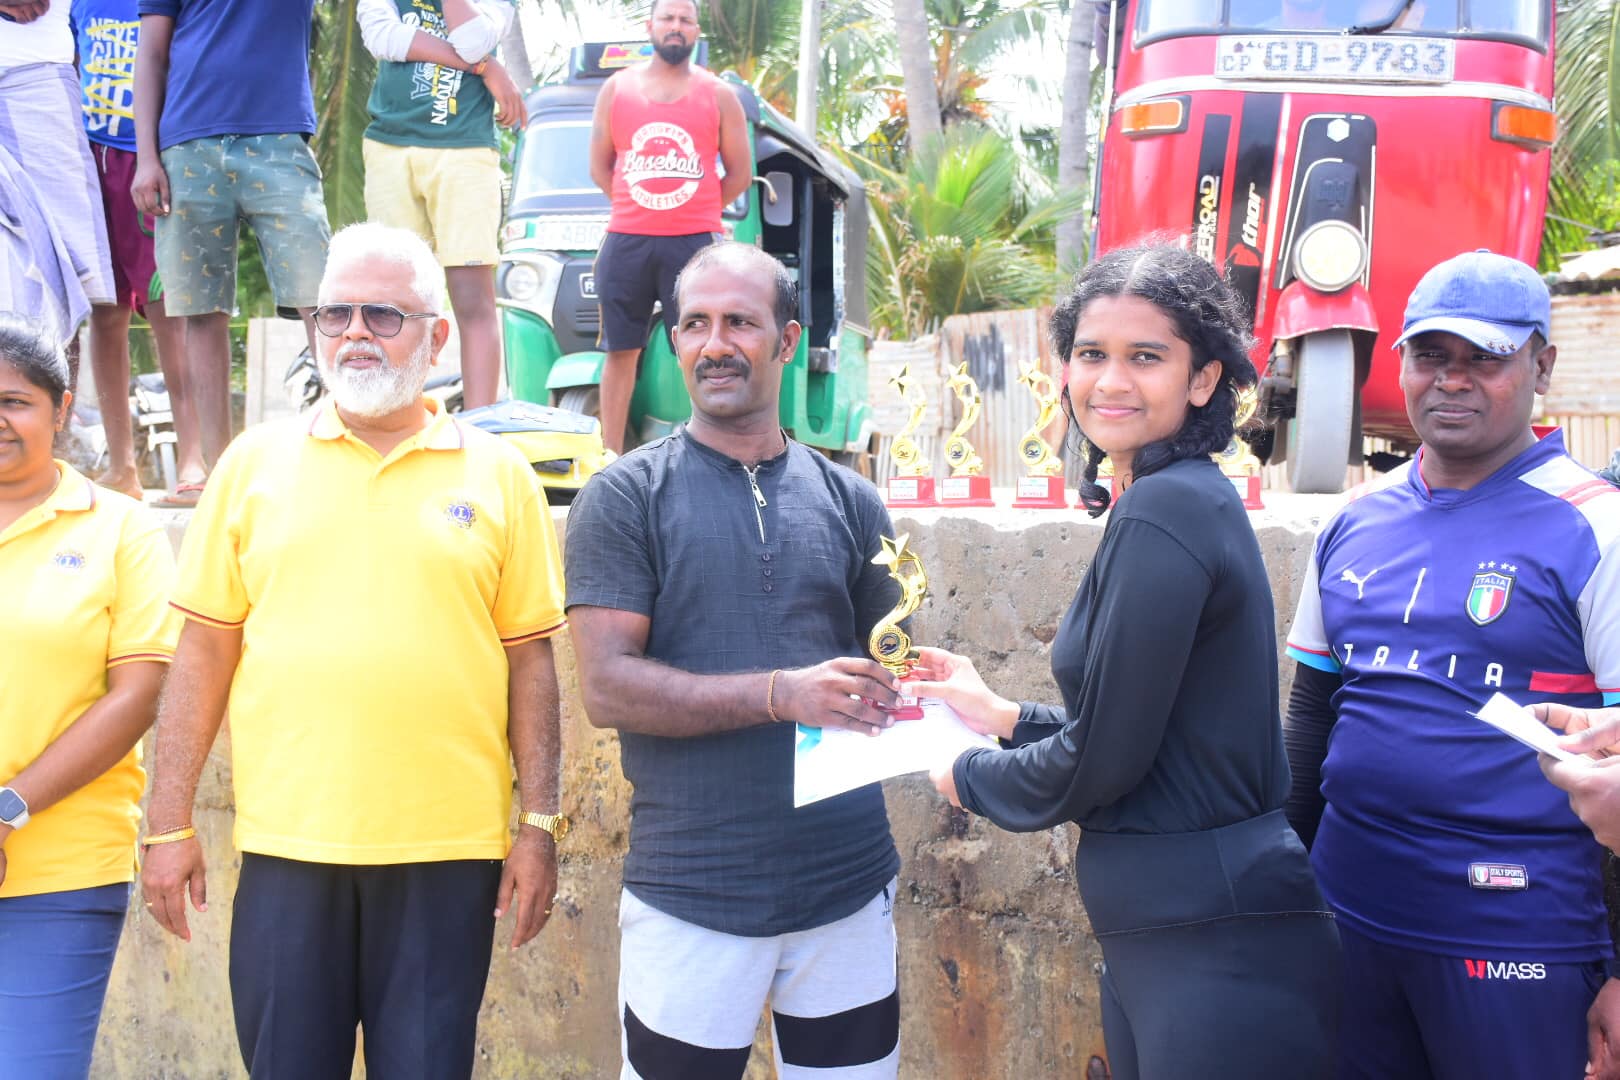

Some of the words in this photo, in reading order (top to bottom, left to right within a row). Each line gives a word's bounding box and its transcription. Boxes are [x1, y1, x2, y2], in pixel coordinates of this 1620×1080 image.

[89, 17, 140, 47] NEVE
[1223, 55, 1251, 72] CP
[1264, 40, 1447, 75] GD-9783
[431, 65, 456, 126] NTOWN
[622, 148, 702, 175] Baseball
[634, 188, 691, 209] ATHLETICS
[1476, 576, 1506, 587] ITALIA
[1343, 643, 1504, 688] TALIA
